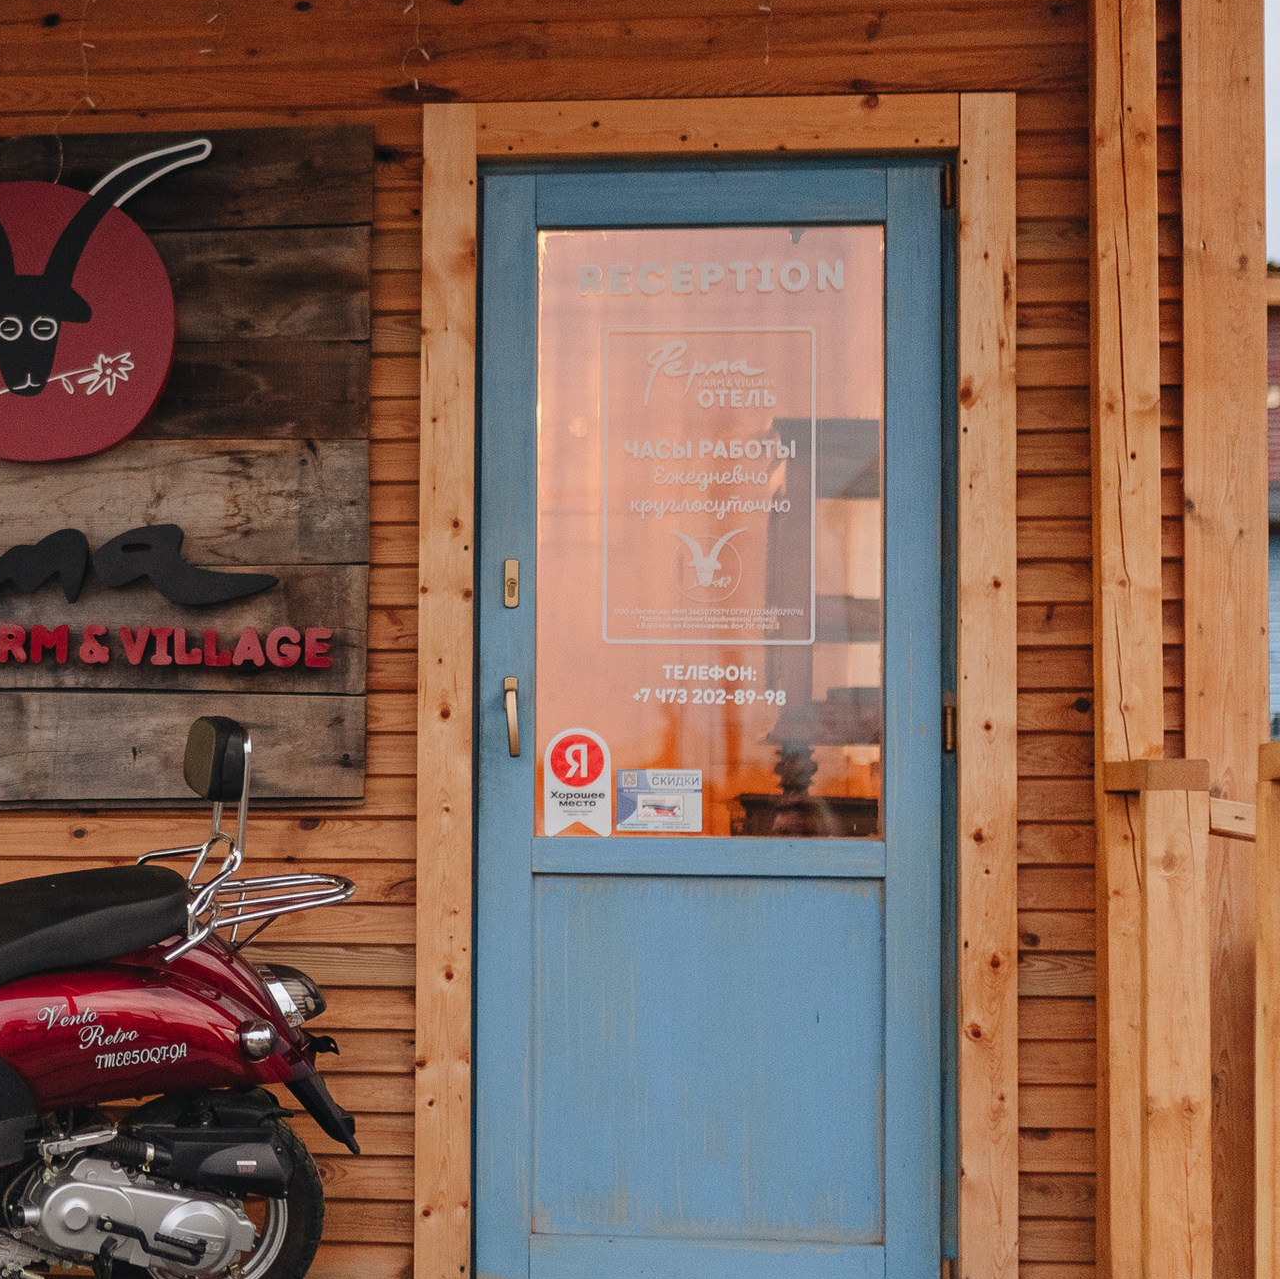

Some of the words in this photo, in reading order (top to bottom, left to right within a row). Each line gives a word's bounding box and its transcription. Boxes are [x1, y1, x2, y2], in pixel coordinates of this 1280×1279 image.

[578, 259, 846, 297] RECEPTION
[644, 340, 766, 406] Ферма
[698, 389, 777, 408] ОТЕЛЬ
[624, 440, 692, 459] ЧАСЫ
[699, 440, 796, 459] РАБОТЫ
[653, 465, 768, 492] Ежедневно
[630, 496, 792, 519] круглосуточно
[78, 625, 110, 664] &
[120, 625, 334, 669] VILLAGE
[662, 663, 757, 683] ТЕЛЕФОН:
[633, 688, 652, 705] +7
[656, 687, 687, 705] 473
[692, 687, 787, 707] 202-89-98
[565, 744, 588, 778] Я
[652, 776, 700, 787] СКИДКИ
[550, 791, 605, 800] Хорошее
[37, 1004, 99, 1030] Vento
[78, 1024, 139, 1050] Retro
